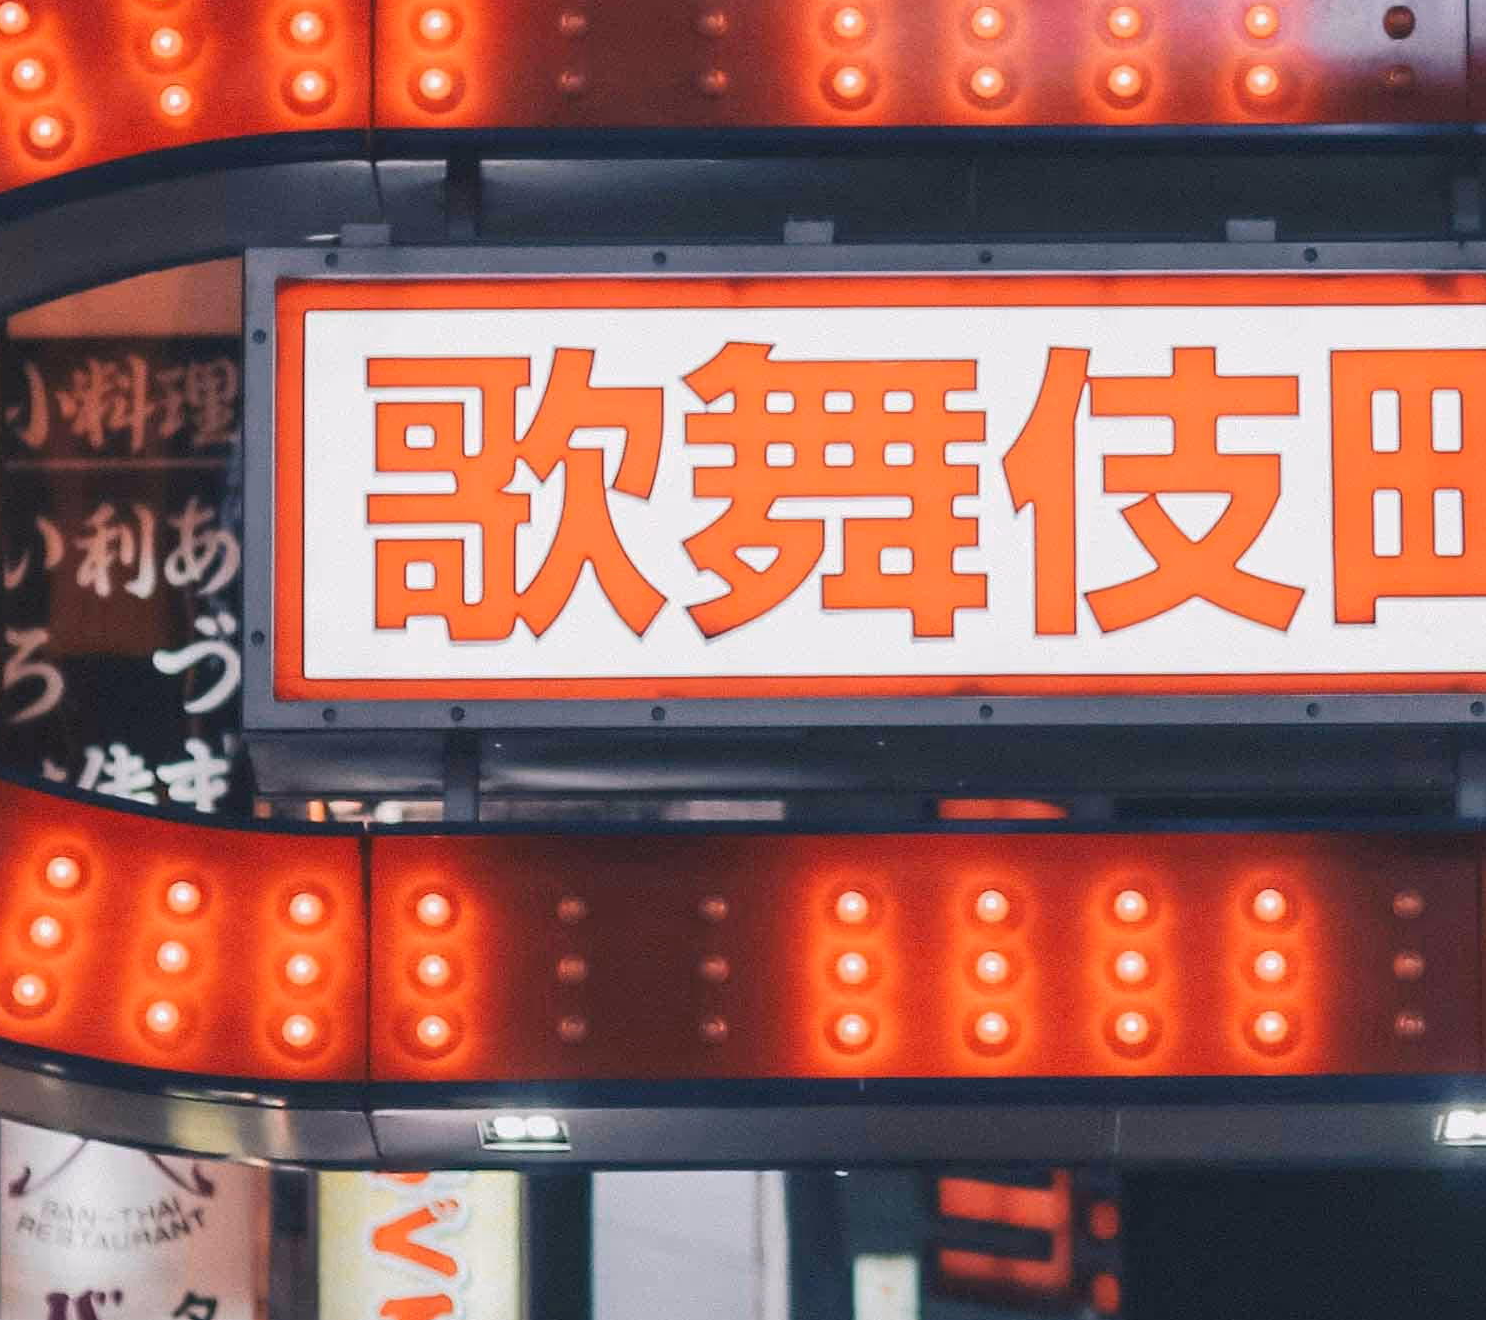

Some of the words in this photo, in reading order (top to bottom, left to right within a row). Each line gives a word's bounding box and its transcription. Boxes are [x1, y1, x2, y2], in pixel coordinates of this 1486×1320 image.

[8, 355, 238, 453] 小料理
[4, 517, 67, 782] いろ
